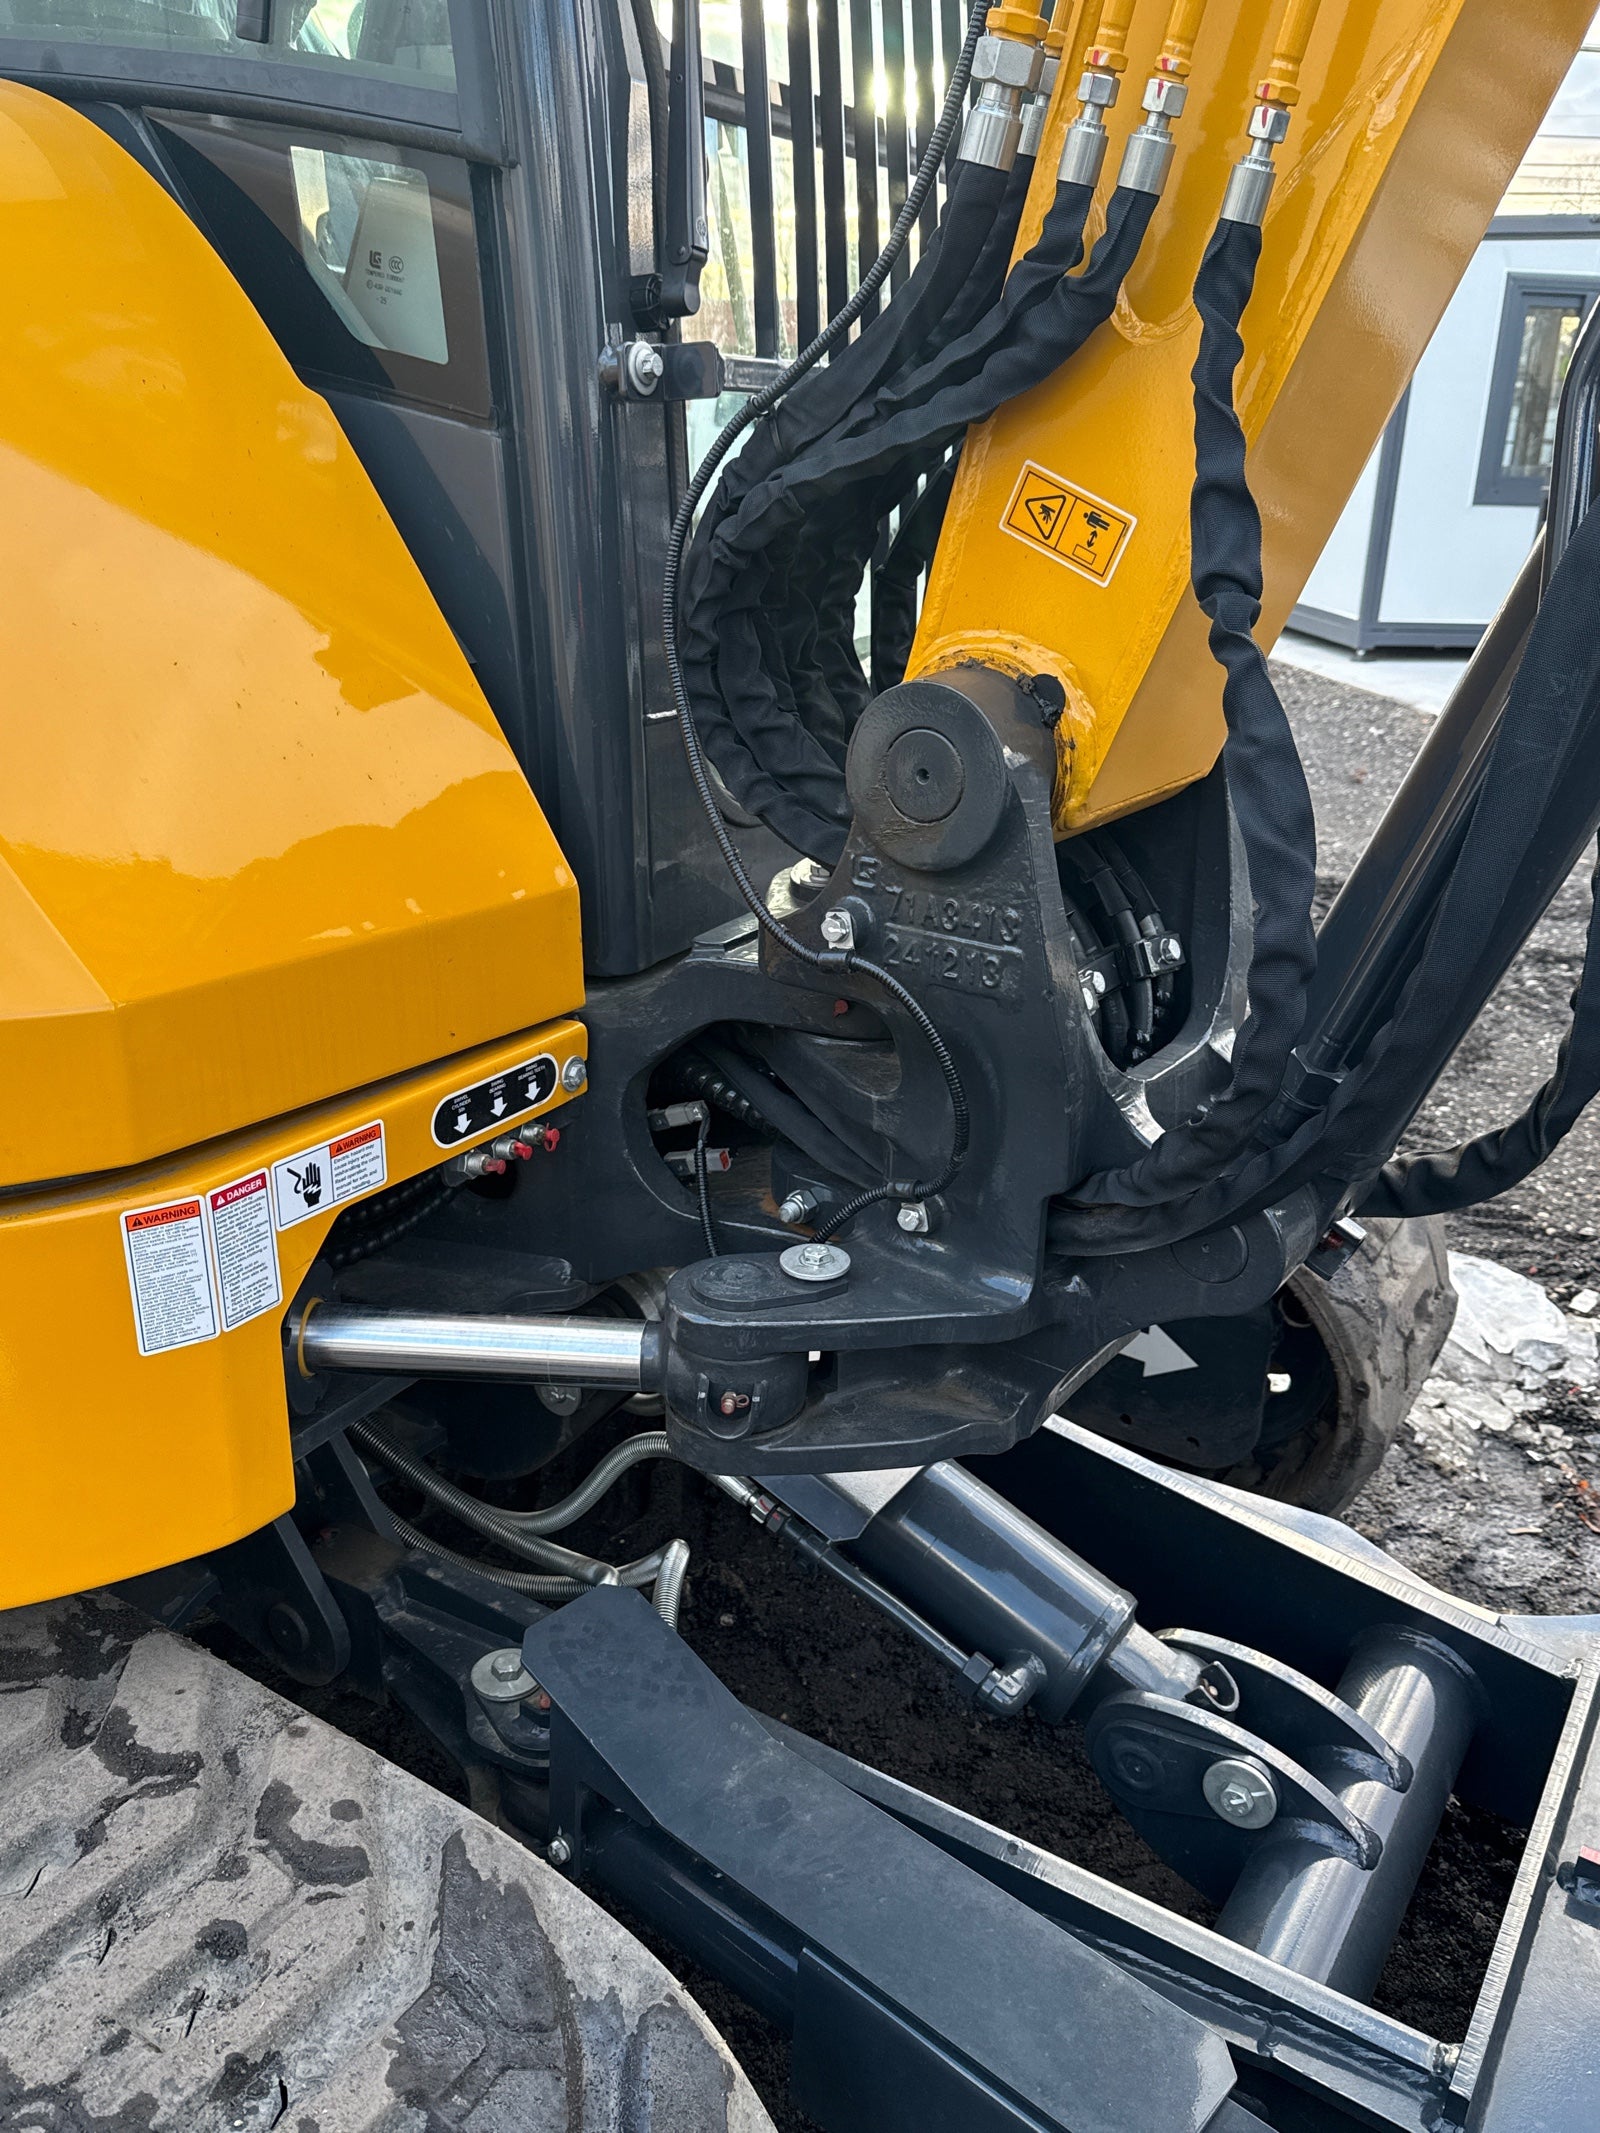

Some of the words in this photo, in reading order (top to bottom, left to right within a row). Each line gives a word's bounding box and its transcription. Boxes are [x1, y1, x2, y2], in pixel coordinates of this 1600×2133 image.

[343, 1130, 376, 1150] WARNING
[226, 1178, 262, 1200] DANGER
[144, 1206, 196, 1224] WARNING
